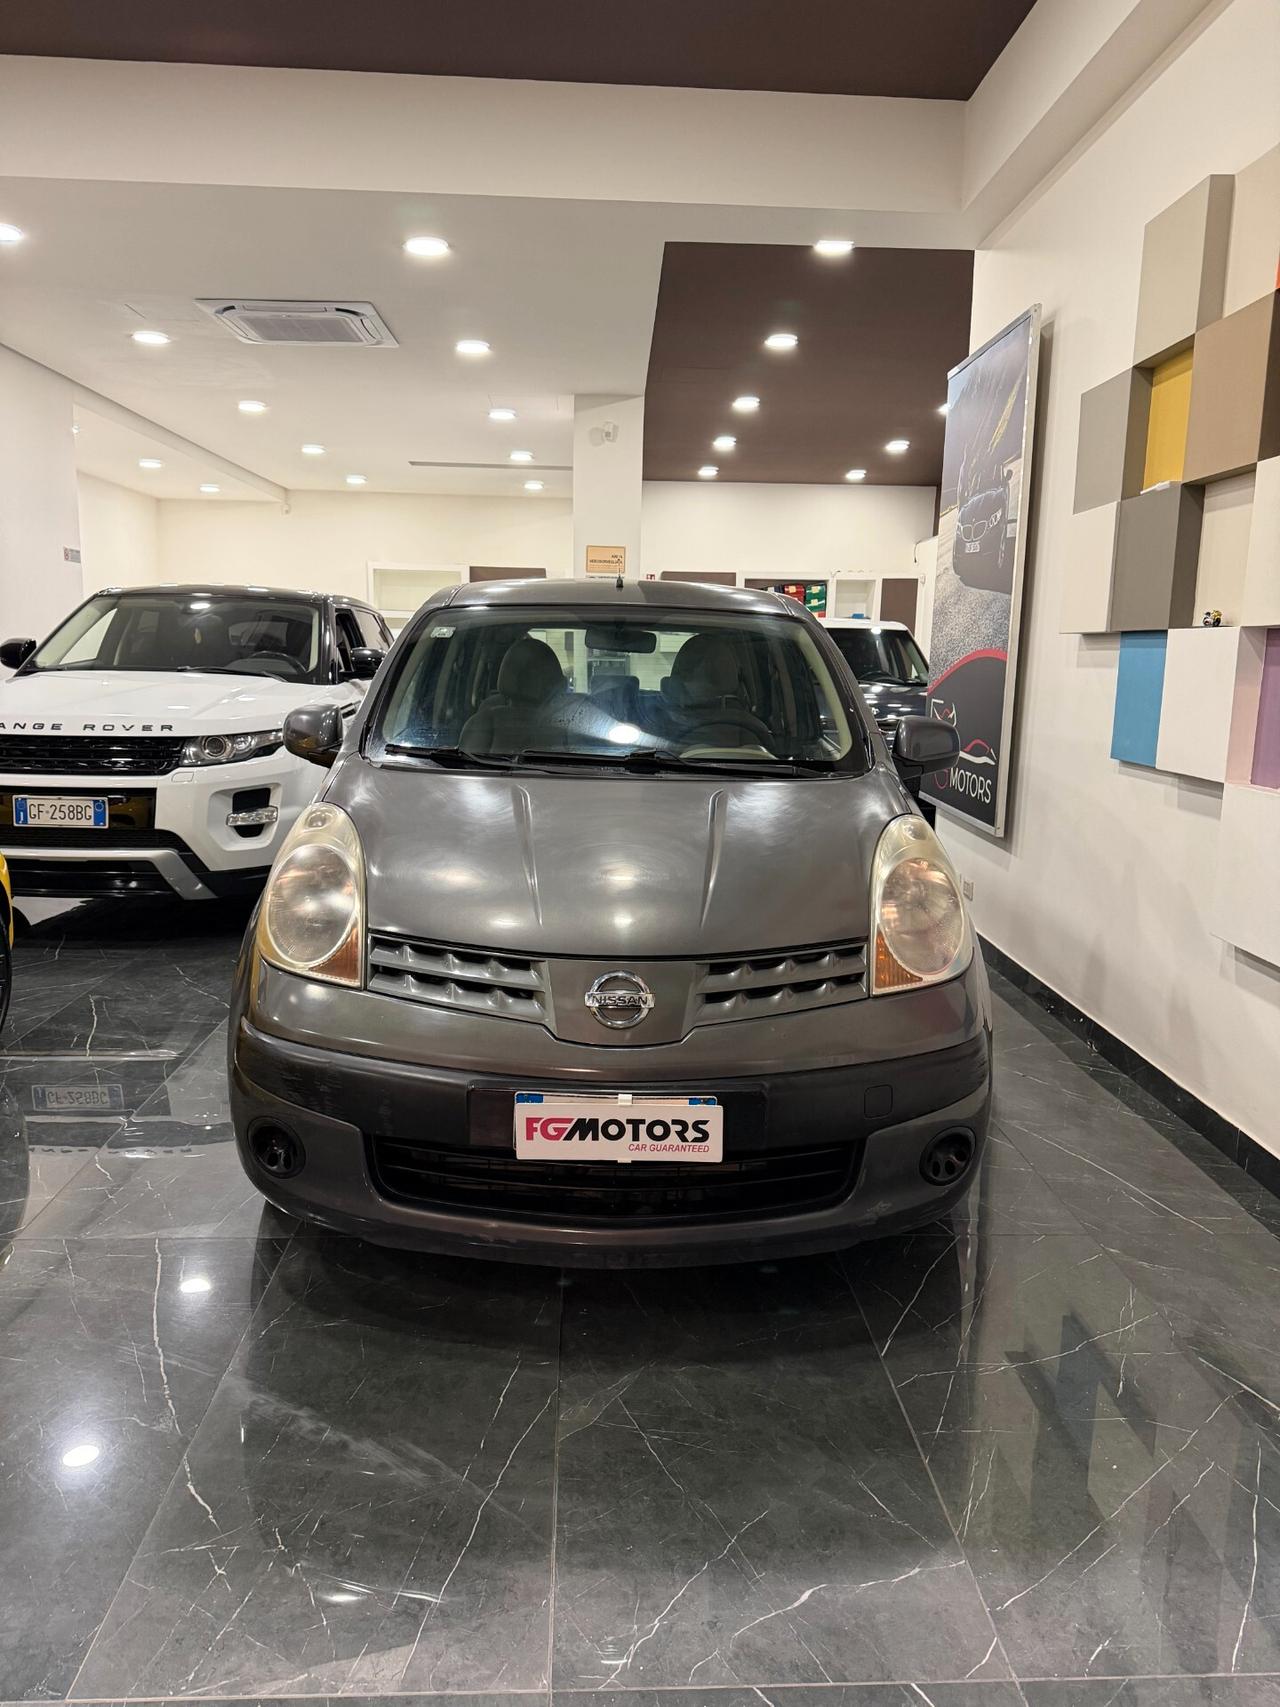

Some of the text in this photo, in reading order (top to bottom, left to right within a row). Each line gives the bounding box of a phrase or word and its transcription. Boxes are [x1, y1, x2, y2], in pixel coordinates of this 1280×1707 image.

[950, 767, 992, 804] MOTORS
[592, 994, 648, 1006] NISSAN
[525, 1117, 710, 1143] FGMOTORS
[628, 1143, 710, 1153] CAR GUARANTEED
